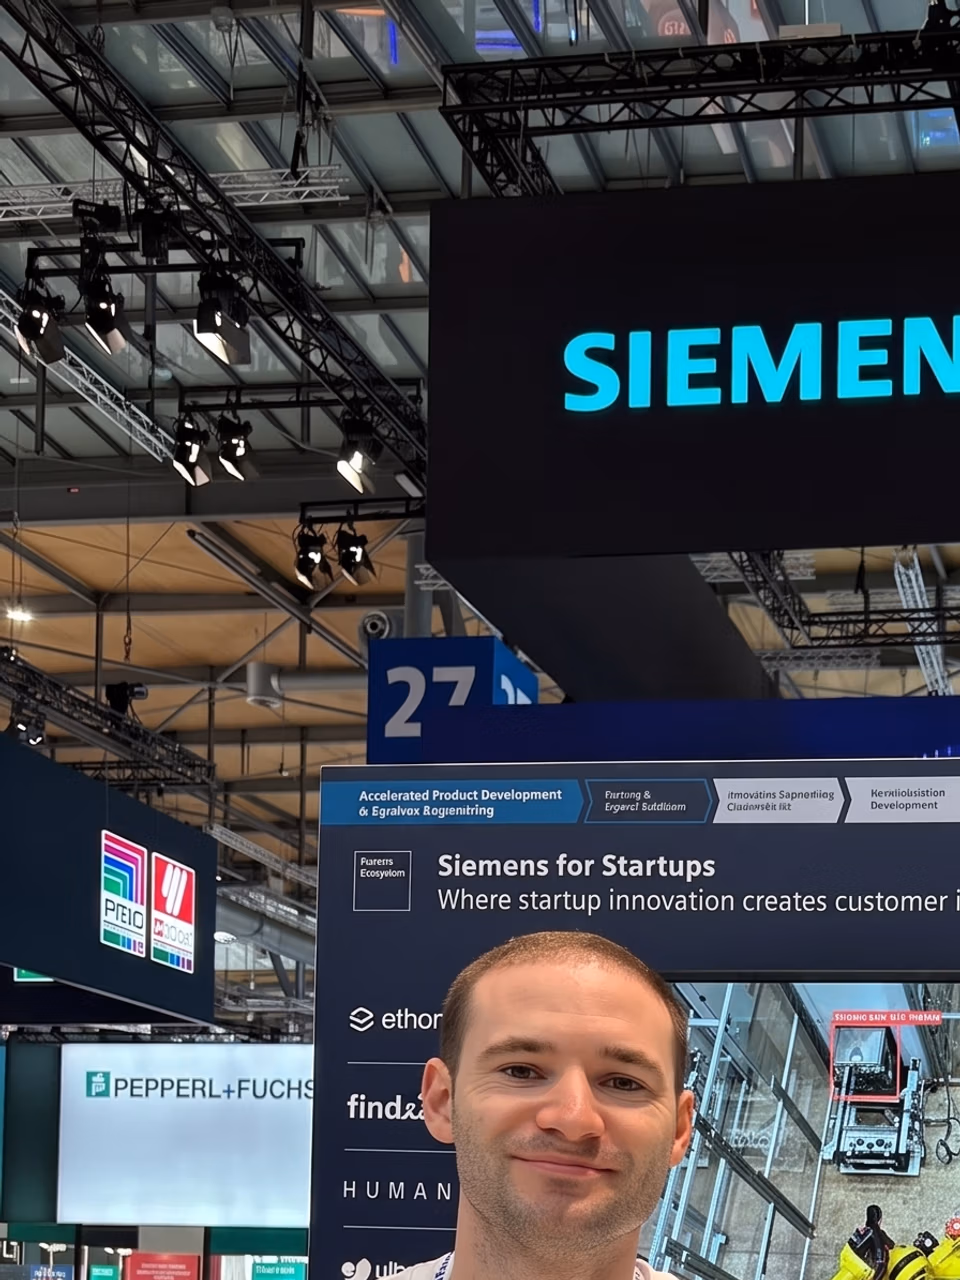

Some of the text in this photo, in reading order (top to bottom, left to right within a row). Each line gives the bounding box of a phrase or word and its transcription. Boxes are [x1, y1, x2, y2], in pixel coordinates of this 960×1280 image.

[385, 665, 476, 738] 27
[359, 788, 563, 803] Accelerated Product Development
[871, 799, 938, 811] Development
[438, 853, 716, 882] Siemens for Startups
[438, 888, 511, 911] Where
[518, 889, 600, 916] startup
[608, 887, 734, 912] innovation
[742, 891, 827, 912] creates
[835, 891, 948, 912] customer
[115, 1077, 314, 1099] PEPPERL+FUCHS
[343, 1180, 452, 1200] HUMAN
